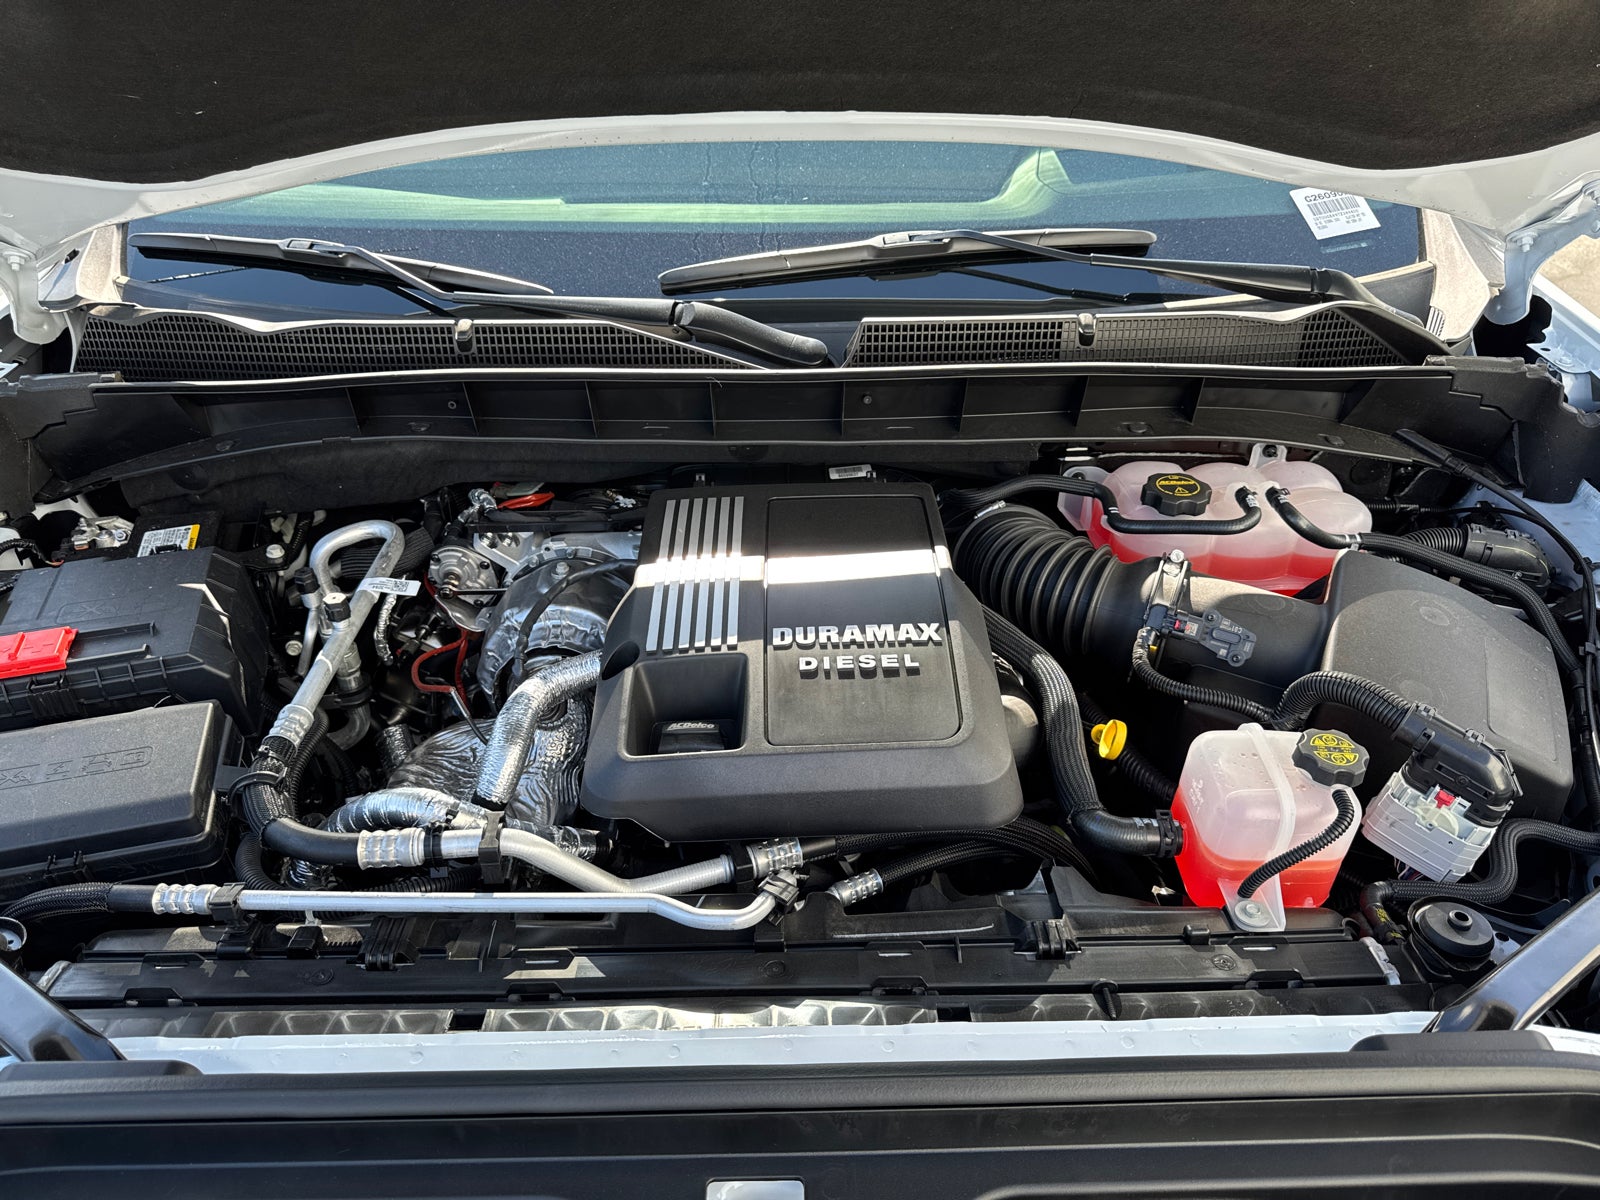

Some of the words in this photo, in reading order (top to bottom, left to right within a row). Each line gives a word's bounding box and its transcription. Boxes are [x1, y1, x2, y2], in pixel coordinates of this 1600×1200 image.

[1304, 191, 1349, 203] G2609
[772, 623, 943, 648] DURAMAX
[799, 653, 920, 674] DIESEL
[667, 722, 715, 731] ACDelco
